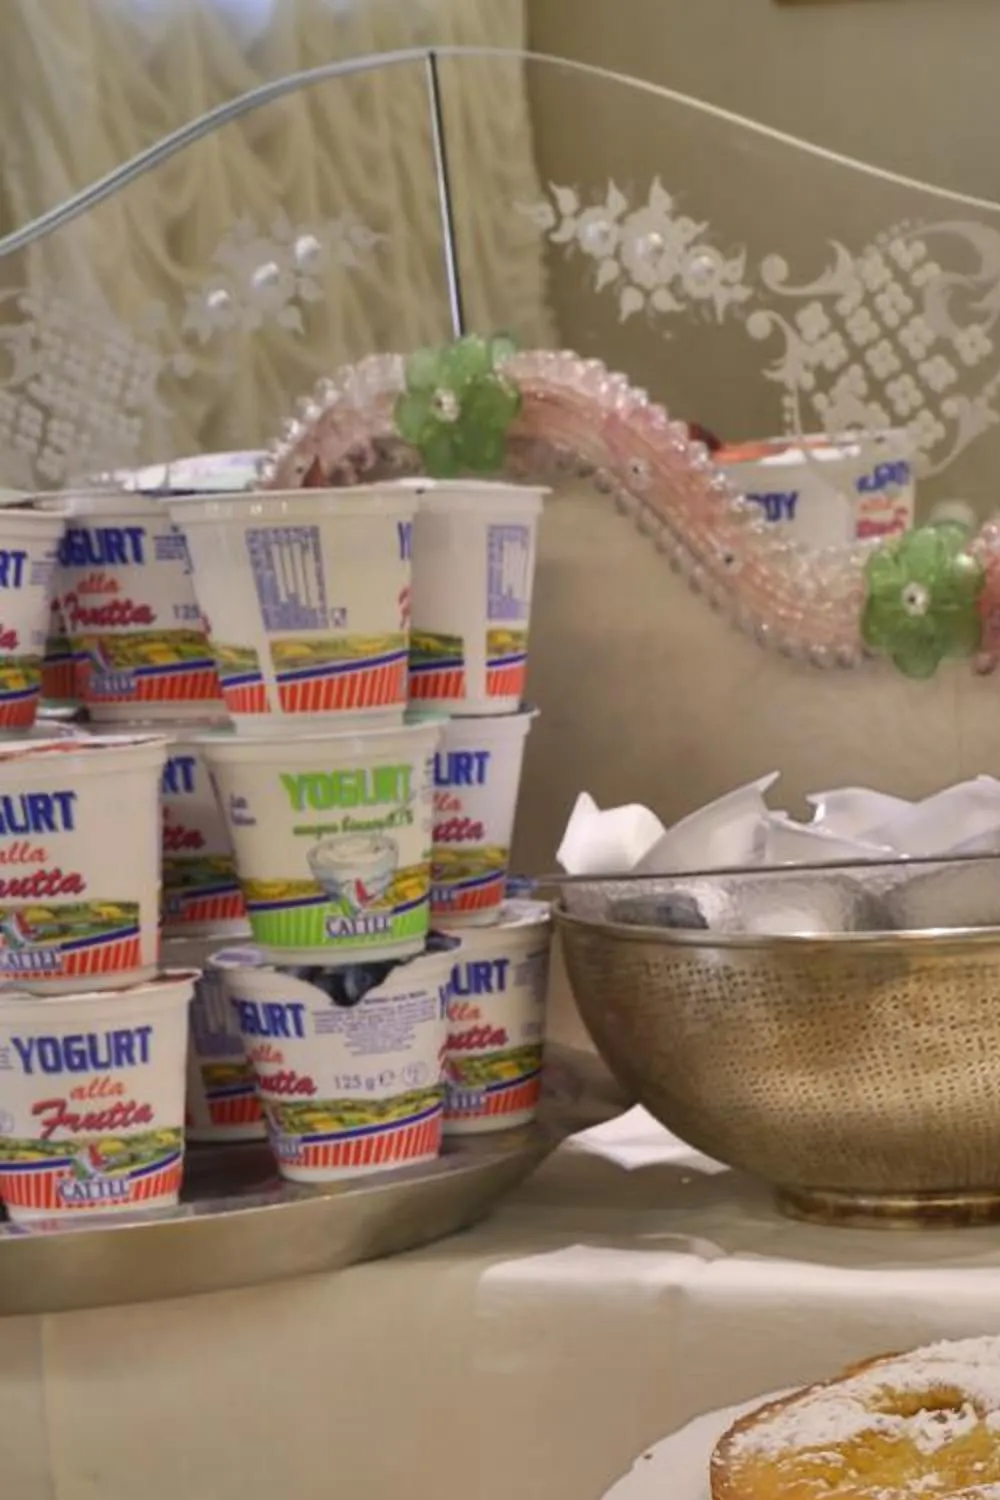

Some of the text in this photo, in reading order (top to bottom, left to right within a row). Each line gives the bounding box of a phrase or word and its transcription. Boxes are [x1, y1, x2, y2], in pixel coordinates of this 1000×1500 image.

[434, 751, 490, 786] URT
[0, 790, 76, 835] URT
[452, 958, 509, 996] URT
[11, 1025, 153, 1075] YOGURT
[70, 1075, 126, 1101] alla
[31, 1097, 154, 1140] Frutta
